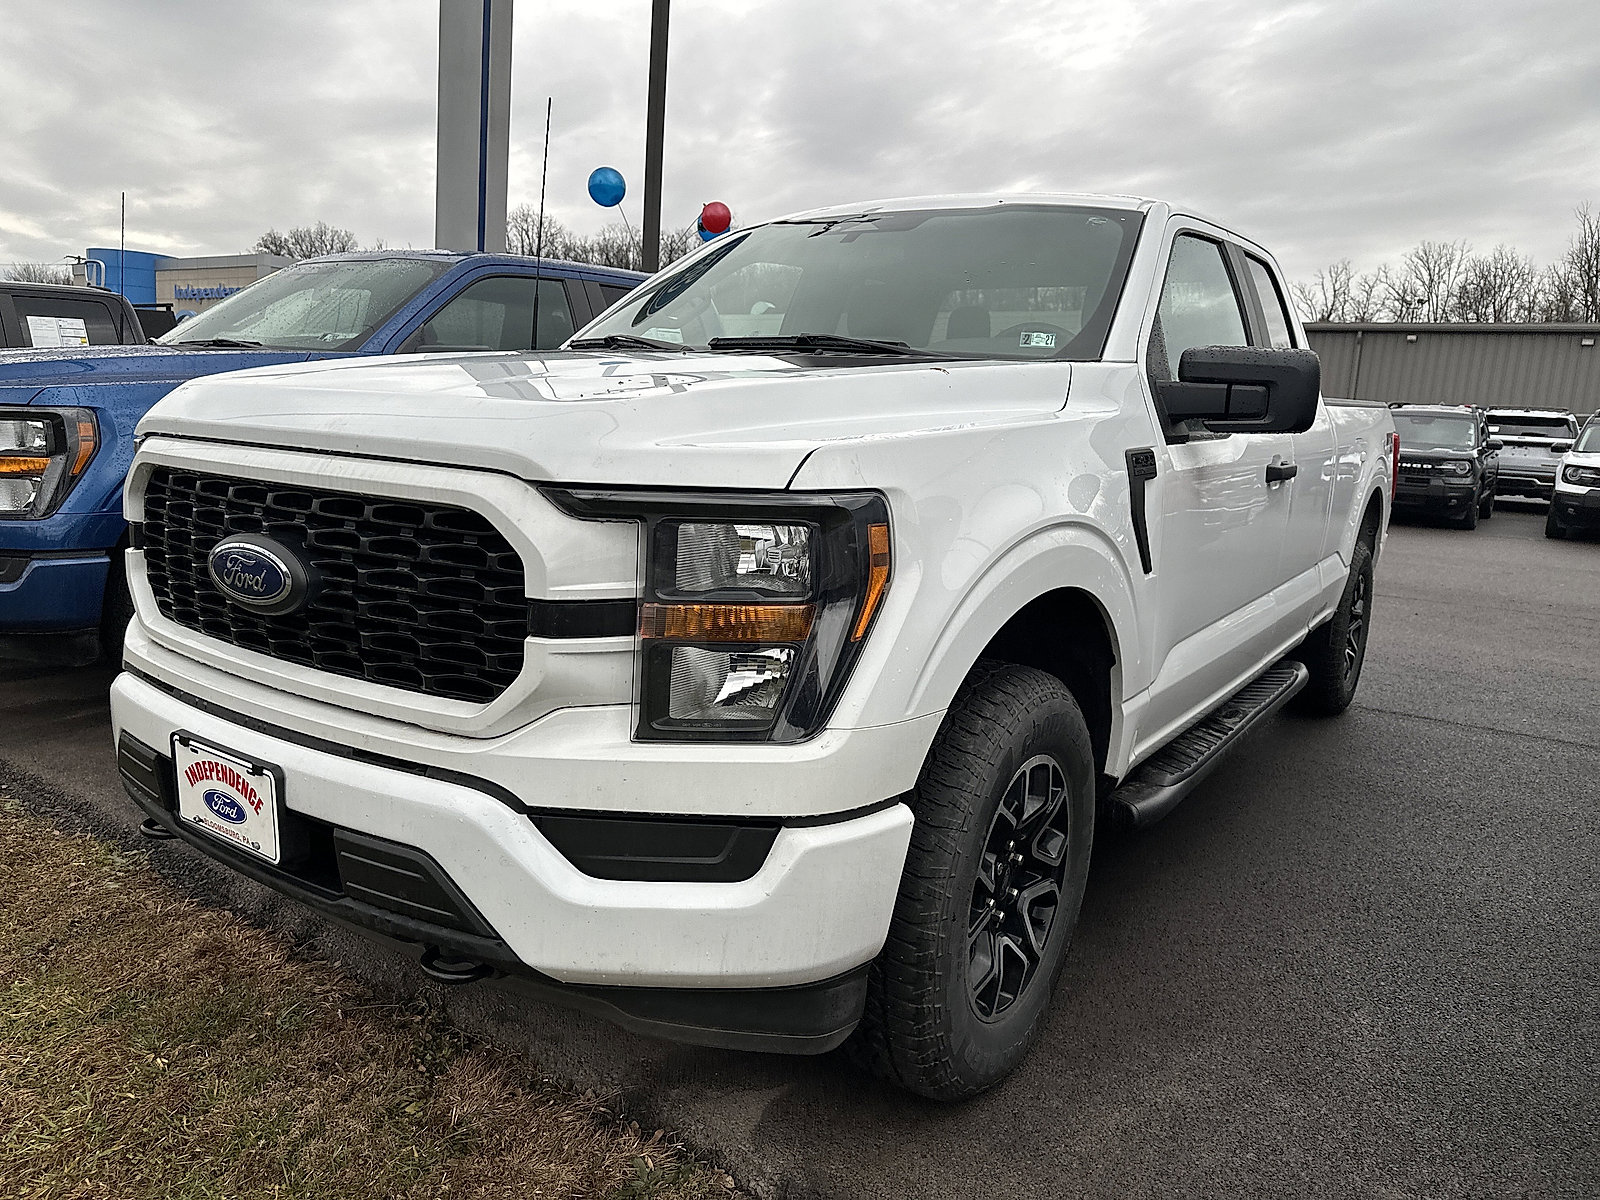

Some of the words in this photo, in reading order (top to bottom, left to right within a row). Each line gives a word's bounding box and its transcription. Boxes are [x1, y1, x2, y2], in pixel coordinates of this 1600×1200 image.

[223, 554, 267, 592] Ford
[184, 760, 265, 815] INDEPENDENCE
[212, 793, 238, 819] Ford
